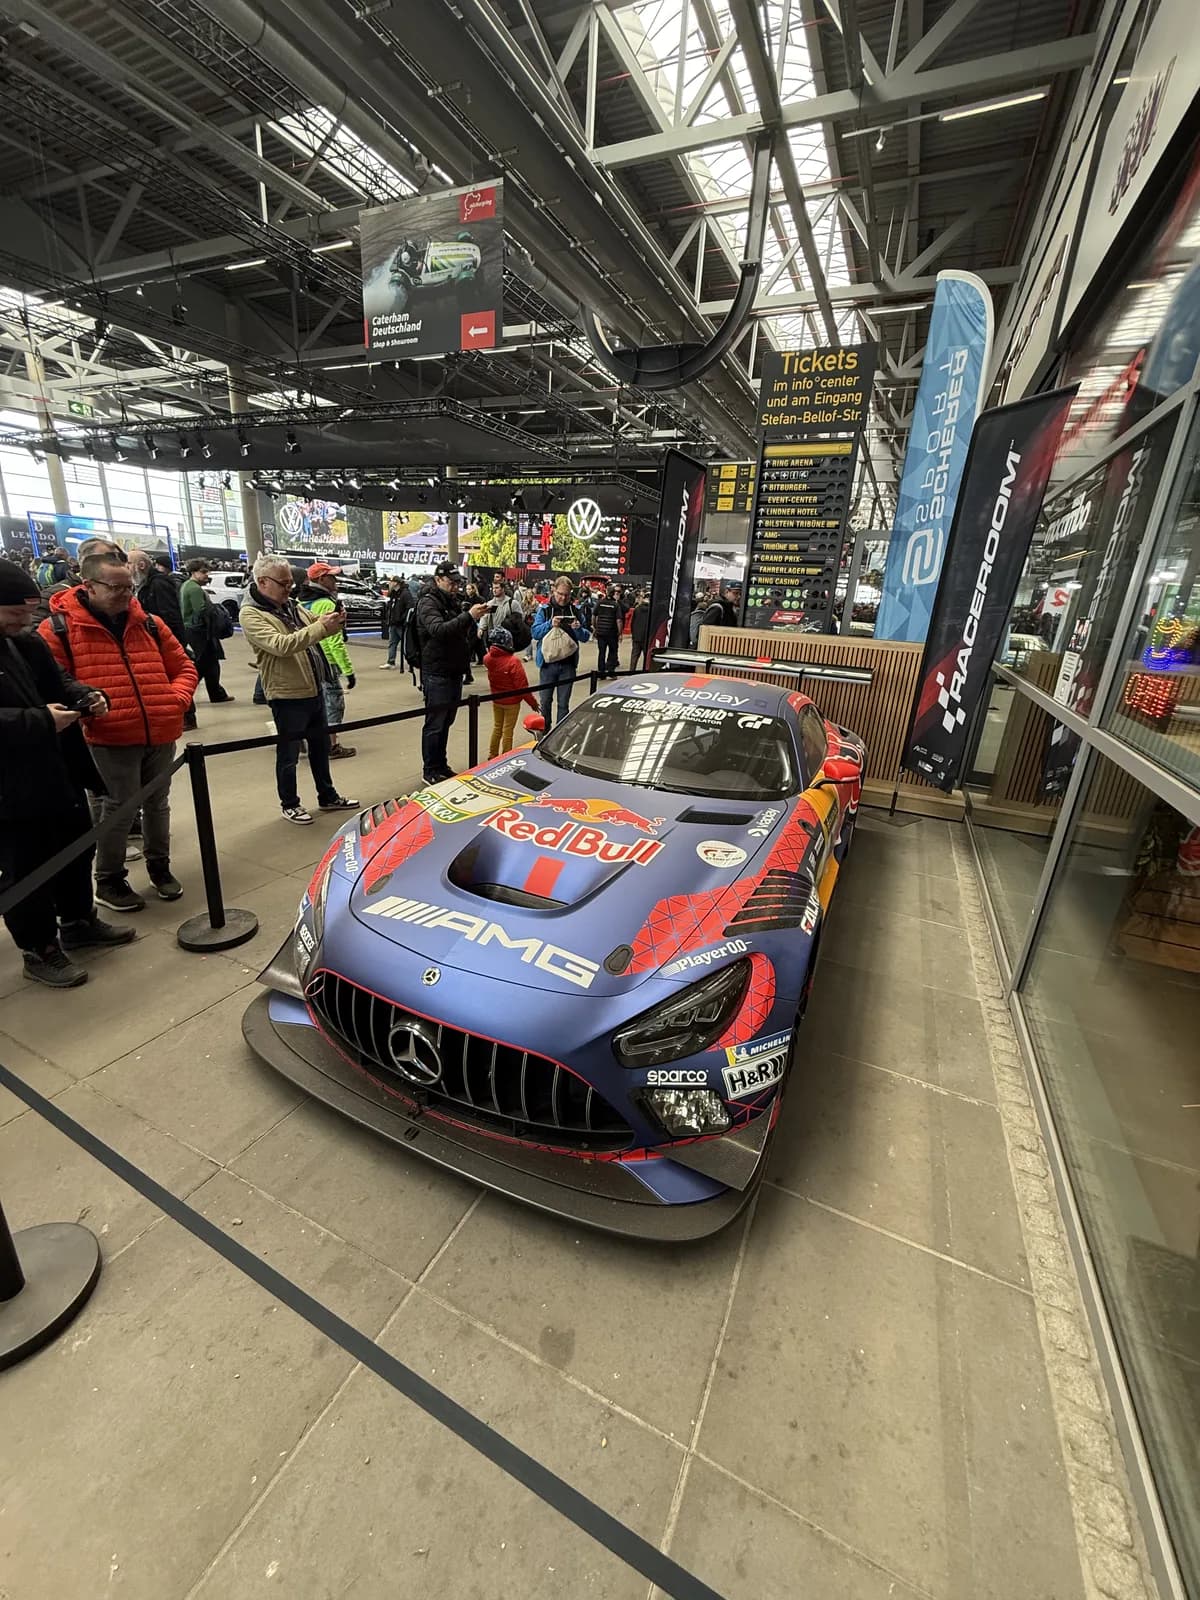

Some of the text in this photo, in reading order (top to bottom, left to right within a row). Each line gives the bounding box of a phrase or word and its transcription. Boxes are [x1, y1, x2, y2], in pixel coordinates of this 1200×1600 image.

[372, 312, 410, 326] Caterham
[372, 319, 422, 337] Deutschland
[373, 341, 386, 349] Shop
[391, 337, 419, 346] Showroom
[781, 349, 858, 375] Tickets
[773, 379, 788, 392] im
[766, 392, 863, 408] und am Eingang
[760, 408, 863, 426] Stefan-Bellof-Str.
[771, 458, 814, 468] RING ARENA
[768, 483, 811, 492] BITBURGER-
[767, 495, 818, 504] EVENT-CENTER
[766, 507, 818, 516] LINDNER HOTEL
[764, 519, 795, 528] BILSTEIN
[796, 519, 825, 528] TRIBÜNE
[762, 543, 787, 551] TRIBÜNE
[352, 547, 377, 560] make
[379, 550, 400, 563] your
[759, 566, 806, 575] FAHRERLAGER
[950, 449, 1022, 702] RACEROOM
[775, 577, 800, 585] CASINO
[480, 806, 665, 866] Red Bull
[424, 912, 601, 989] AMG
[750, 1034, 791, 1056] MICHELIN
[647, 1070, 706, 1085] sparco
